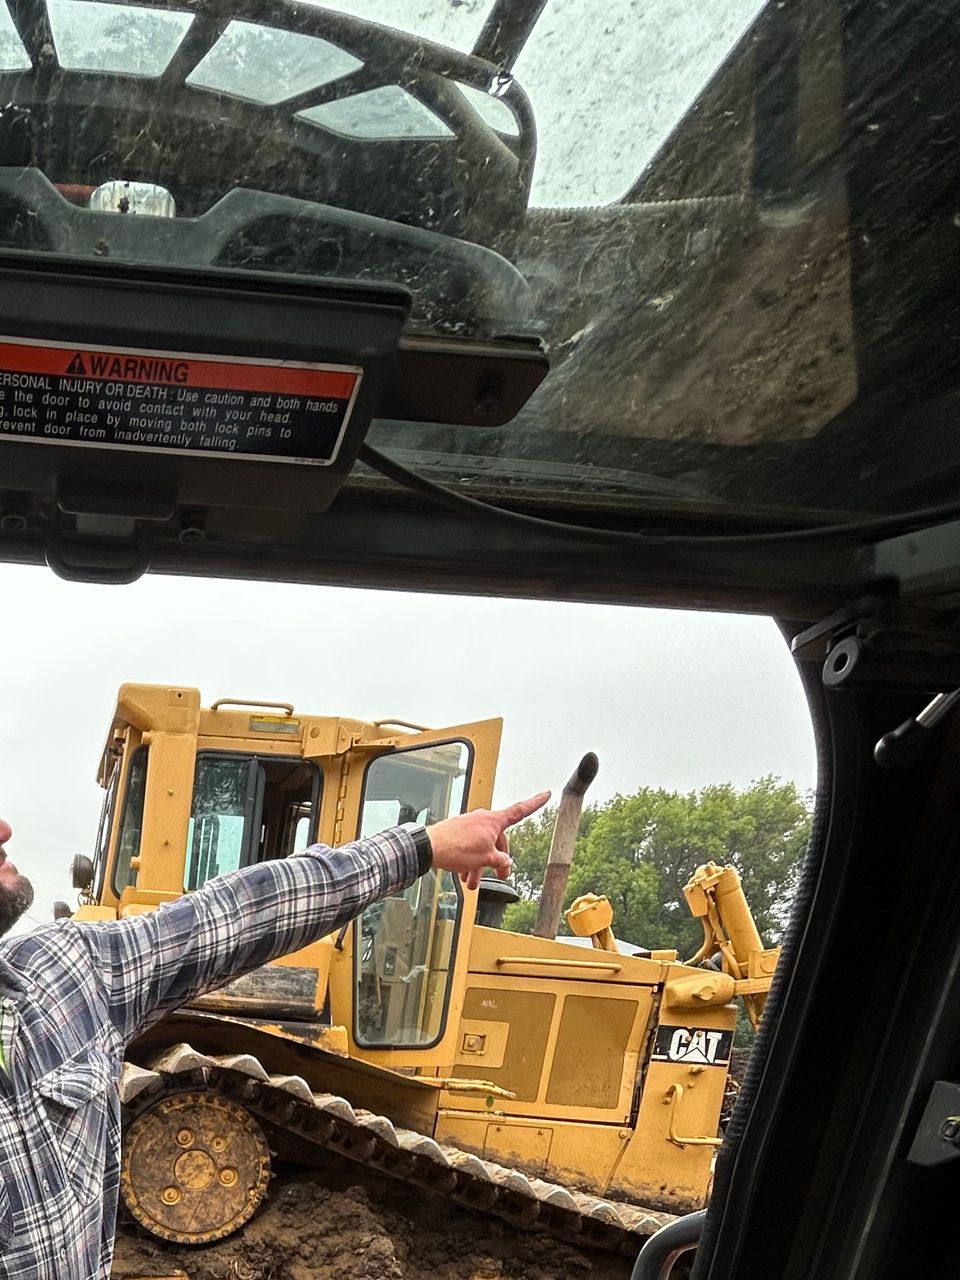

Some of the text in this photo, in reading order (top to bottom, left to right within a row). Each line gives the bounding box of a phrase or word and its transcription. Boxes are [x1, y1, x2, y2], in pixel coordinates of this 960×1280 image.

[90, 356, 189, 383] WARNING
[15, 391, 33, 403] the
[42, 394, 70, 406] door
[79, 396, 89, 408] to
[99, 399, 131, 412] avoid
[140, 402, 184, 415] contact
[192, 406, 217, 418] with
[225, 410, 251, 422] your
[260, 410, 292, 424] head.
[59, 378, 102, 394] INJURY
[106, 383, 124, 396] OR
[177, 391, 199, 402] Use
[205, 394, 244, 405] caution
[250, 396, 271, 407] and
[277, 397, 300, 409] both
[306, 400, 338, 413] hands
[14, 405, 37, 418] lock
[46, 408, 57, 419] in
[65, 410, 98, 423] place
[107, 413, 121, 428] by
[129, 415, 171, 432] moving
[180, 419, 206, 432] both
[215, 421, 239, 434] lock
[247, 425, 272, 437] pins
[280, 427, 291, 439] to
[44, 422, 71, 435] door
[80, 425, 106, 438] from
[114, 429, 192, 447] inadvertently
[200, 435, 239, 450] falling.
[669, 1028, 723, 1063] CAT
